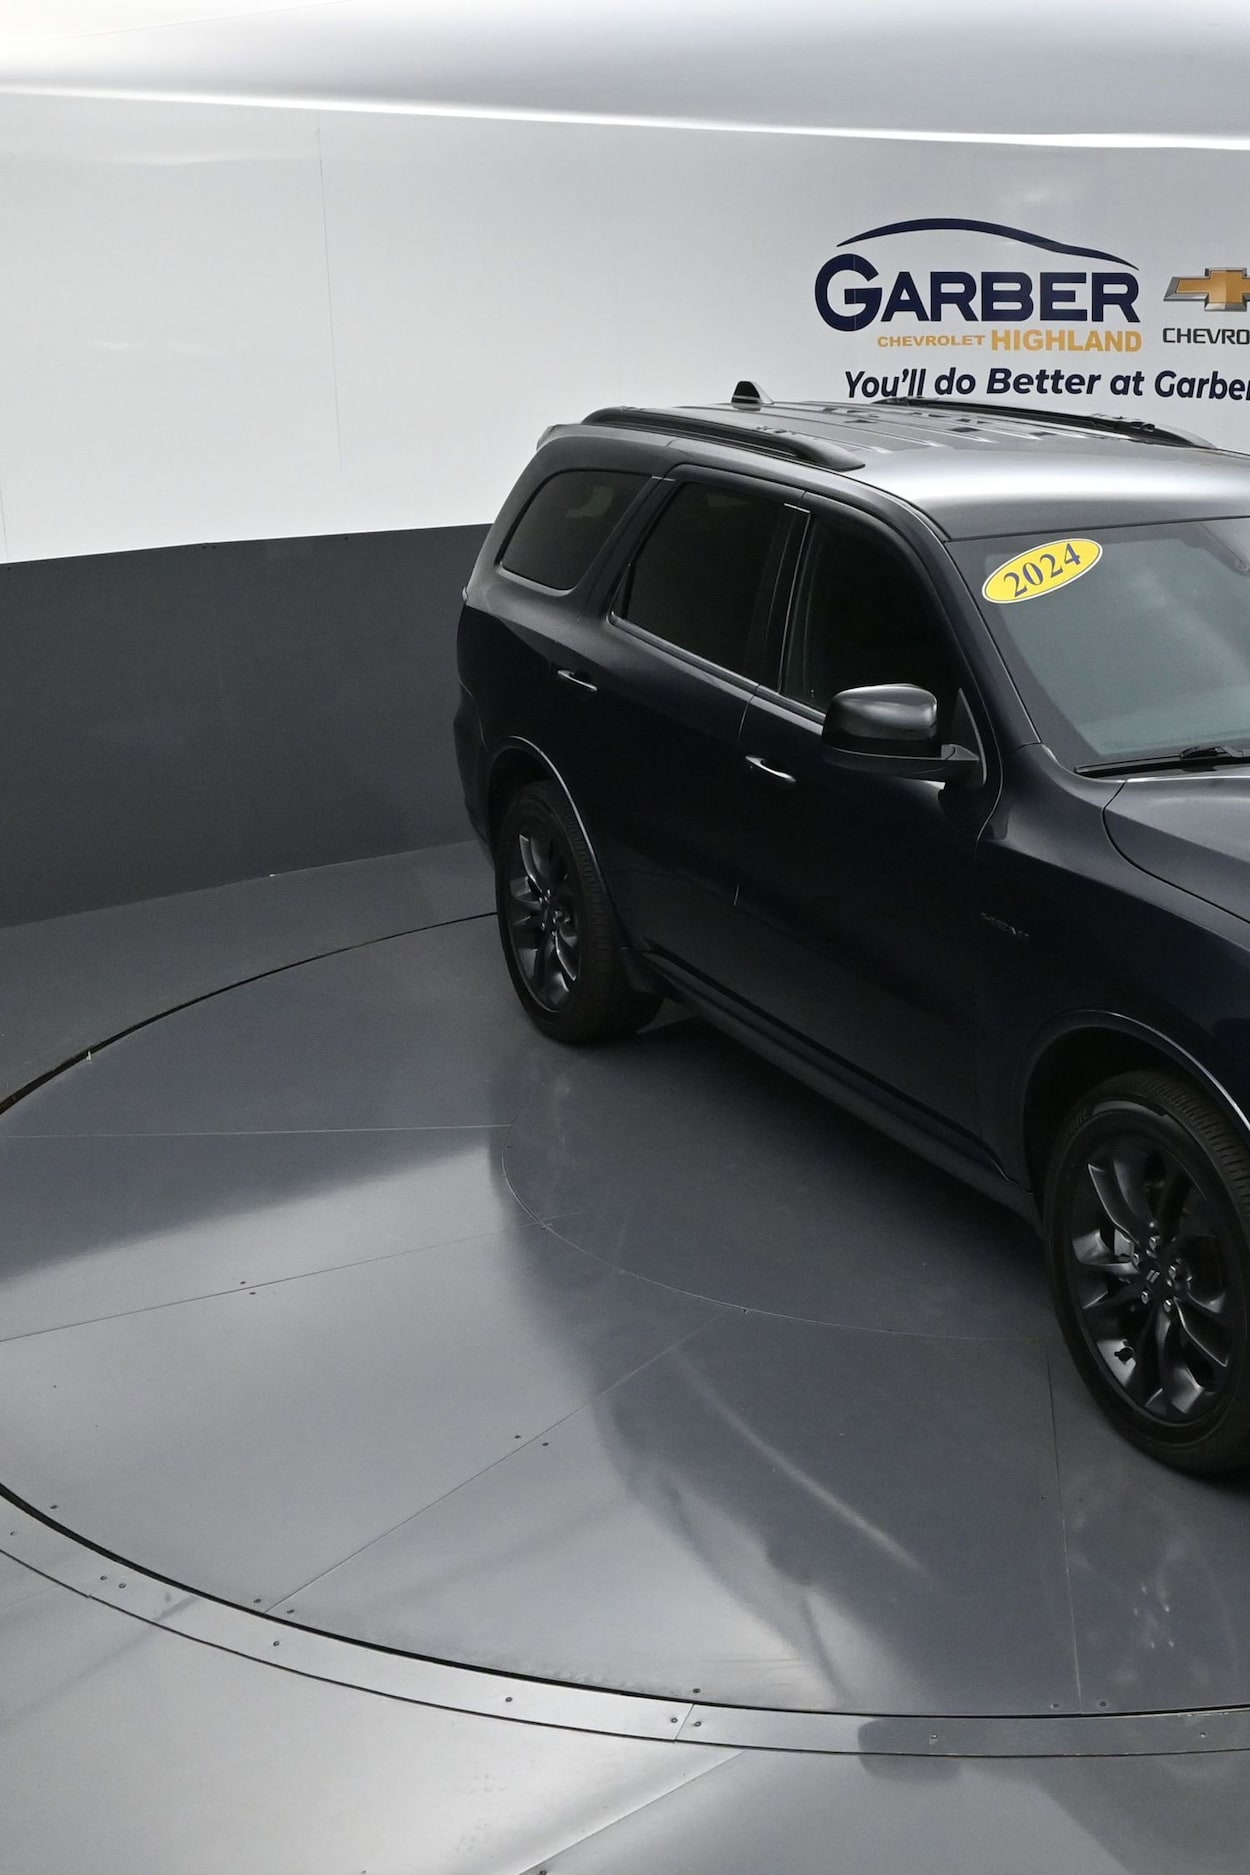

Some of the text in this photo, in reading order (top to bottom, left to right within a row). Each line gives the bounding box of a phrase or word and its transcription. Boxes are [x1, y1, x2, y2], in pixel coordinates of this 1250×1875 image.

[814, 253, 1141, 332] GARBER
[877, 329, 1143, 353] CHEVROLET HIGHLAND
[845, 368, 927, 399] You'll
[934, 366, 977, 396] do
[987, 367, 1103, 396] Better
[1109, 371, 1145, 397] at
[1003, 543, 1081, 598] 2024
